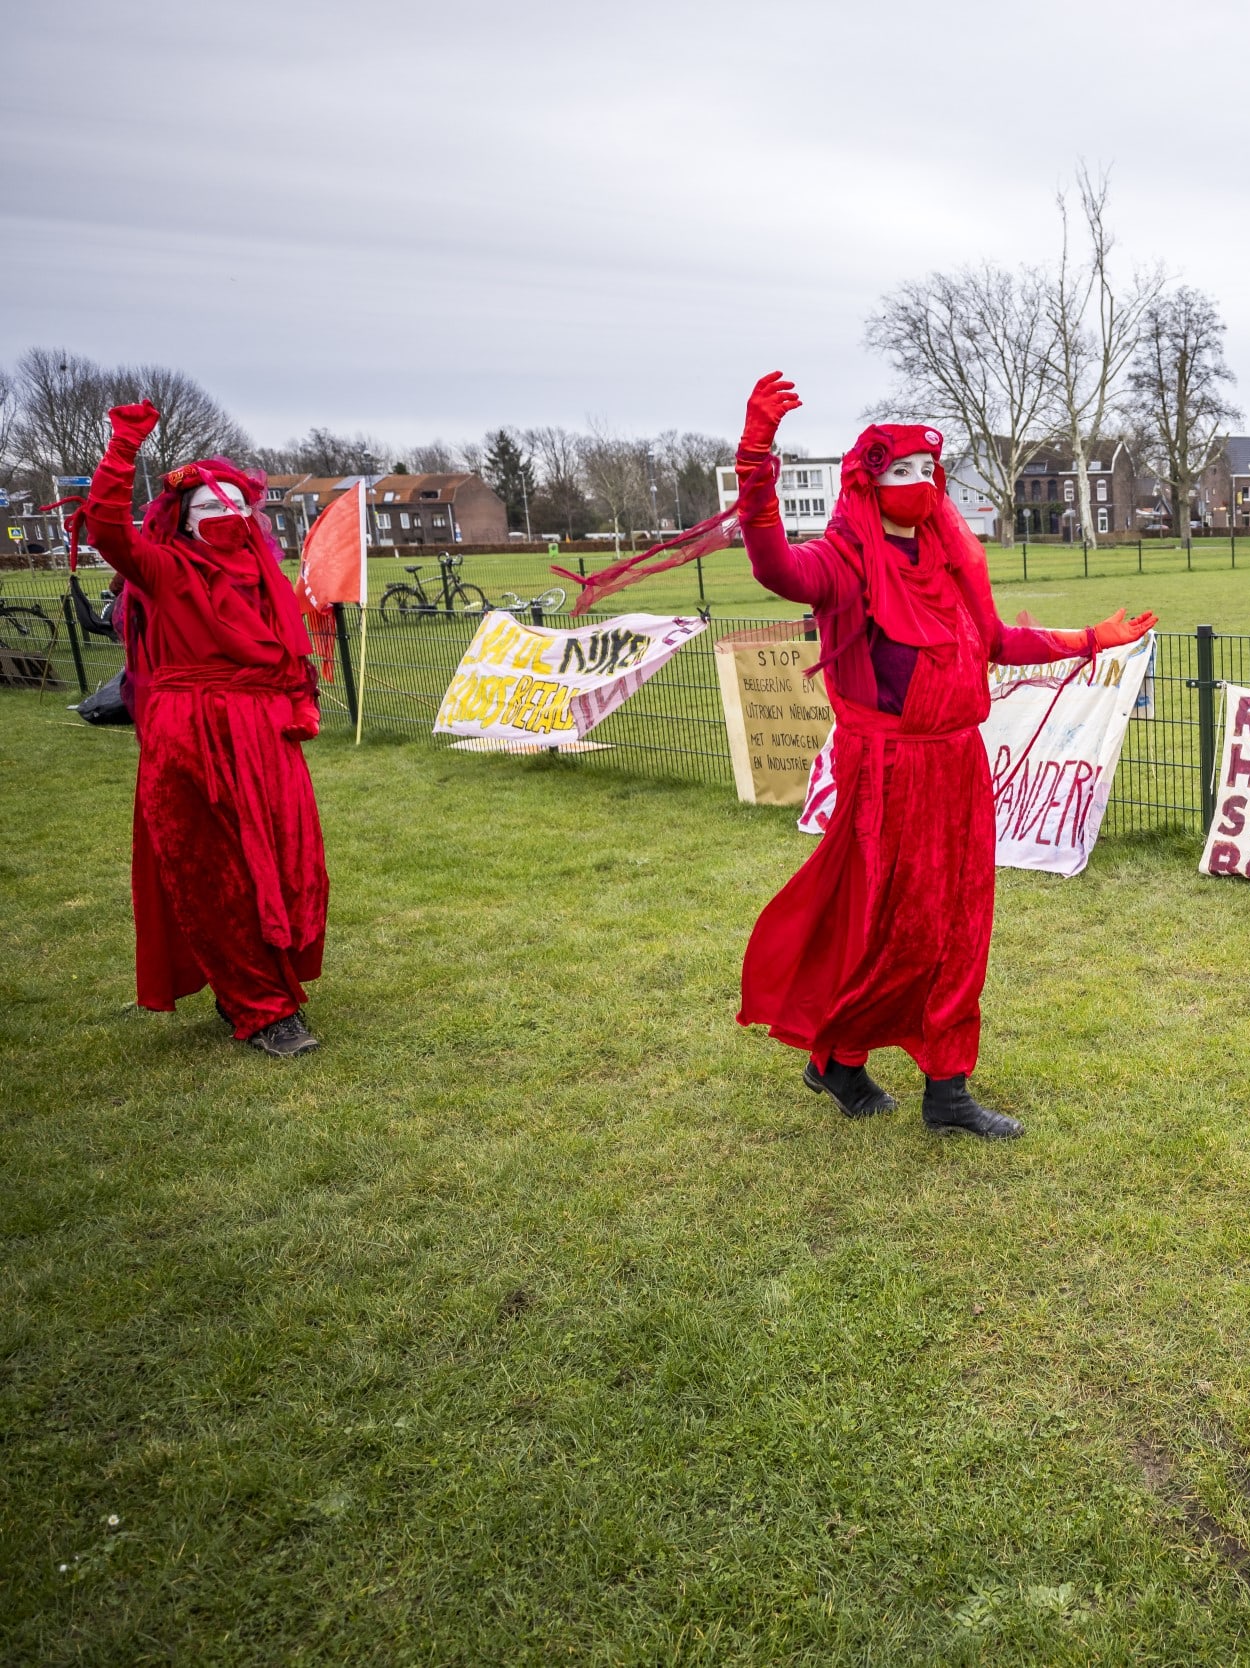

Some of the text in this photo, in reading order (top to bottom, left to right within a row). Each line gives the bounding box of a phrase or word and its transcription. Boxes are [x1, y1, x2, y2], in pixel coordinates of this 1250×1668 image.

[757, 650, 801, 667] STOP
[743, 676, 816, 694] BELEGERING EN
[500, 674, 577, 734] BETAL
[745, 701, 784, 720] UITROKEN
[750, 732, 820, 749] MET AUTOWEGEN
[753, 754, 810, 771] EN INDUSTRIE
